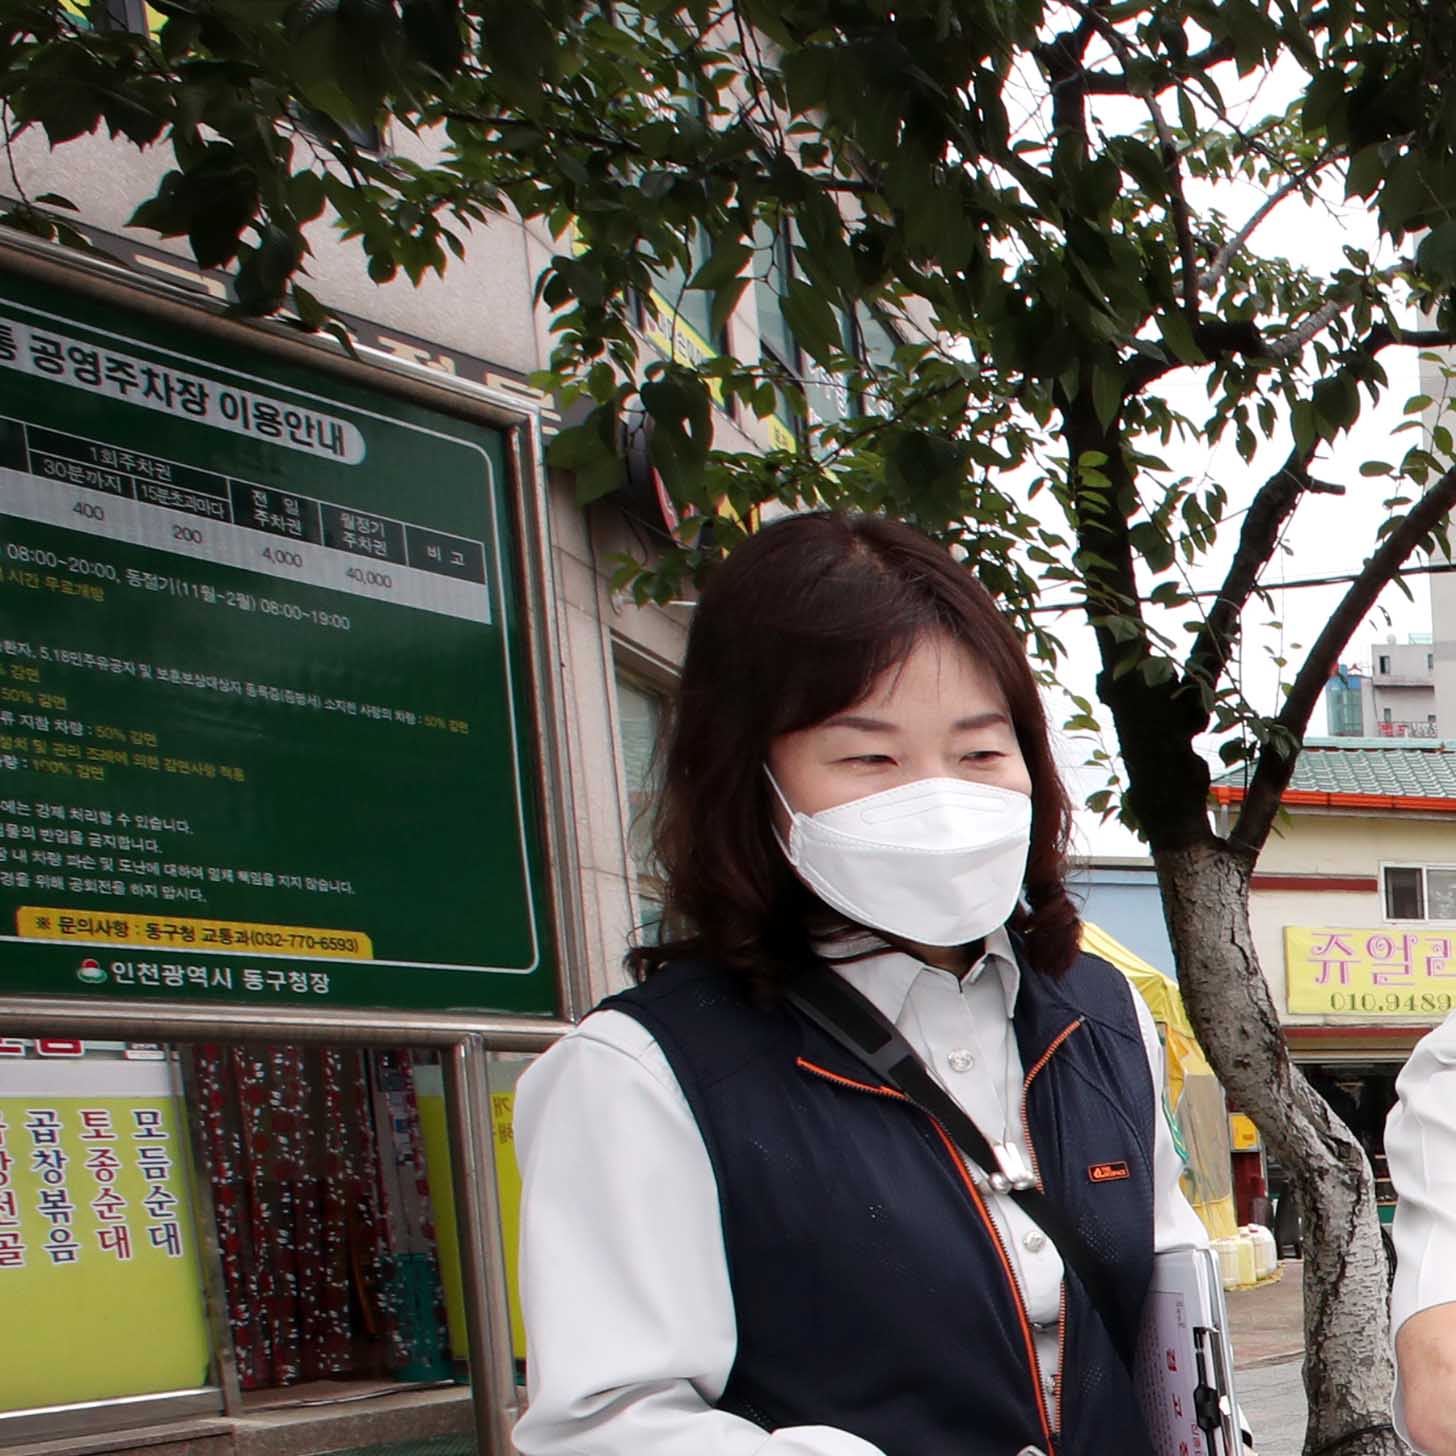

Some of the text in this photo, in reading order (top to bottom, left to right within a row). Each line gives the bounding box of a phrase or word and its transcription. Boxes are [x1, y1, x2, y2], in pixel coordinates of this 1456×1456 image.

[29, 334, 210, 416] 공영주차장
[219, 391, 345, 457] 이용안내
[43, 458, 122, 494] 30분까지
[90, 446, 172, 482] 1회주차권
[72, 501, 105, 521] 400
[253, 508, 302, 537] 주차권
[172, 523, 204, 544] 200
[342, 531, 387, 556] 주차권
[261, 546, 303, 568] 4,000
[345, 567, 392, 589] 40,000
[117, 812, 132, 828] 수
[135, 814, 194, 835] 있습니다.
[39, 828, 84, 846] 반입을
[88, 832, 163, 854] 금지합니다.
[130, 882, 158, 898] 하지
[57, 916, 130, 938] 문의사항
[145, 921, 197, 943] 동구청
[201, 926, 359, 954] 교통과(032-770-6593)
[110, 960, 331, 995] 인천광역시 동구청장
[26, 1109, 80, 1264] 곱창볶음
[79, 1109, 131, 1260] 토종순대
[132, 1109, 182, 1257] 모듬순대
